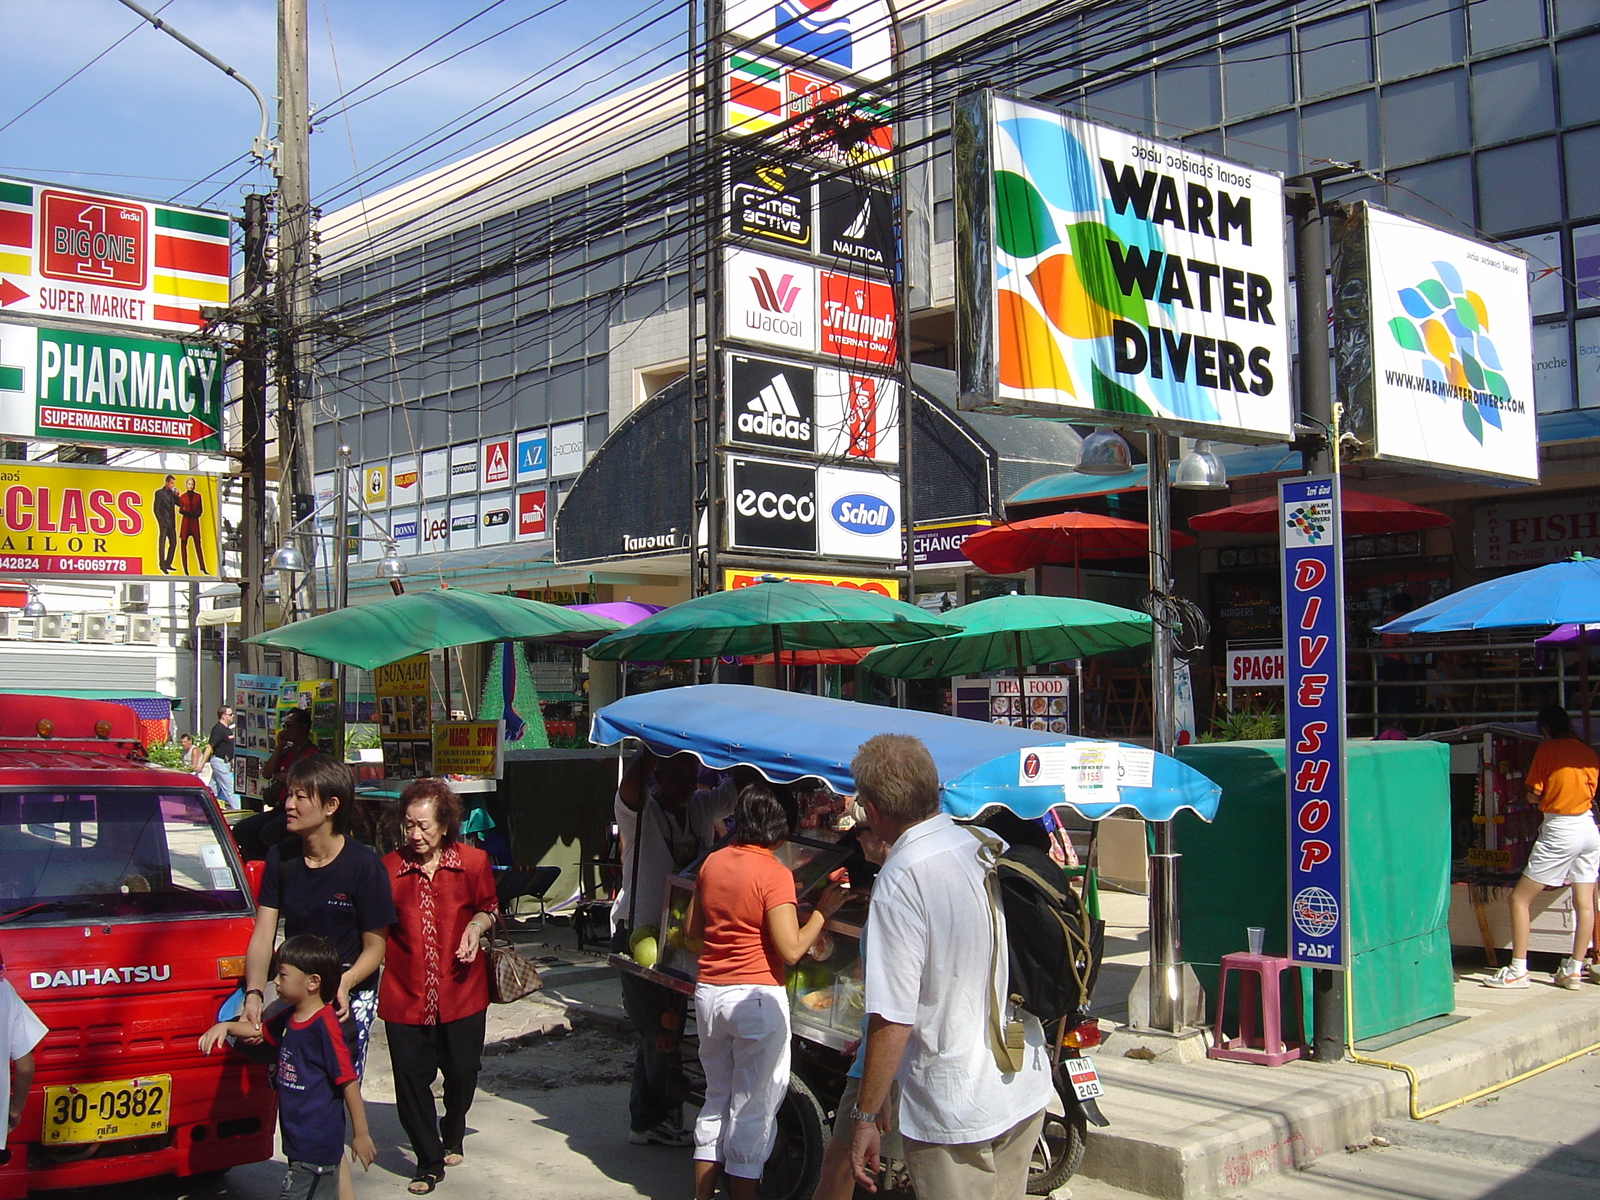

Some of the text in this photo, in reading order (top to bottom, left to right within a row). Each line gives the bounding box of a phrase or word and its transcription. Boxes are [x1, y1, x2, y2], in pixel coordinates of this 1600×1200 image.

[1099, 156, 1253, 247] WARM
[54, 226, 135, 265] BIG ONE
[832, 239, 884, 263] NAUTICA
[1104, 239, 1276, 327] WATER
[39, 287, 146, 322] SUPER MARKET
[823, 300, 895, 342] Triumph
[828, 333, 891, 354] INTERNATONA
[1112, 318, 1275, 398] DIVERS
[1534, 357, 1568, 372] roche
[40, 339, 218, 414] PHARMACY
[1384, 369, 1526, 415] WWW.WARMWATERDIVERS.COM
[44, 408, 193, 437] SUPERMARKET BASEMENT
[737, 412, 811, 441] adidas
[522, 445, 543, 467] AZ
[522, 511, 541, 524] PUMA
[737, 489, 815, 523] ecco
[839, 501, 889, 527] Scholl
[394, 523, 417, 538] BONNY
[423, 517, 447, 543] Lee
[1506, 511, 1600, 546] FISH
[59, 558, 127, 573] 01-6069778
[1220, 608, 1255, 618] BURGERS
[1293, 557, 1329, 709] DIVE
[378, 662, 427, 688] TSUNAMI
[1233, 655, 1285, 681] SPAGH
[996, 679, 1063, 694] THA FOOD
[450, 728, 470, 746] MAGIC
[1082, 772, 1100, 782] 1155
[1294, 720, 1332, 873] SHOP
[1298, 942, 1332, 959] PADI
[30, 964, 171, 990] DAIHATSU
[1078, 1083, 1099, 1098] 249
[52, 1086, 164, 1126] 30-0382
[150, 1121, 162, 1130] 86
